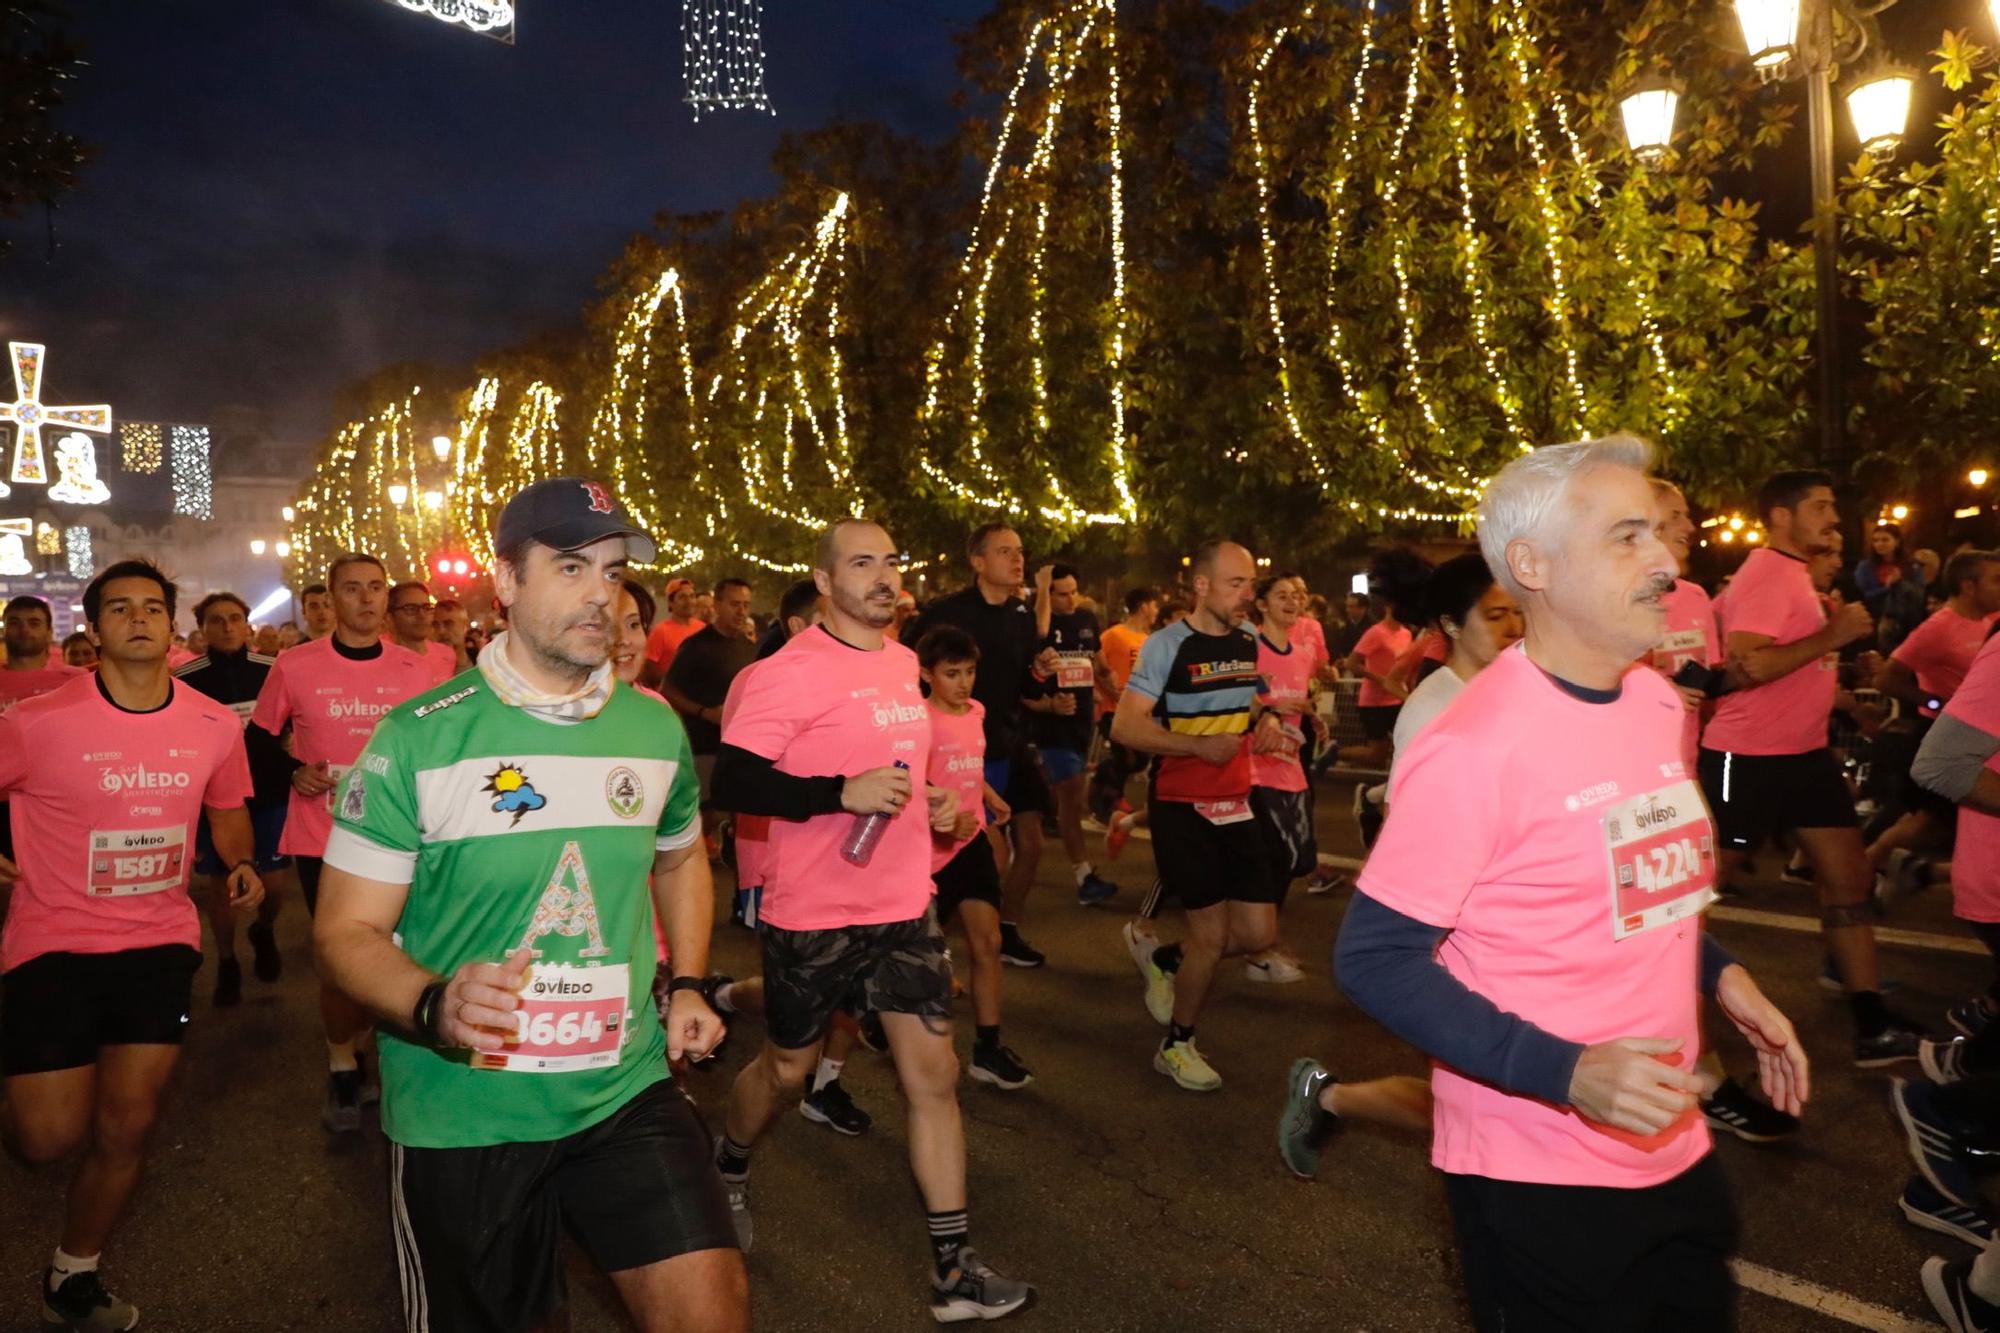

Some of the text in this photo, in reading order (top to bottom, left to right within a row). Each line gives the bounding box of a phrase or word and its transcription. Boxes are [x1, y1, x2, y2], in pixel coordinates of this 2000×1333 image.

[414, 686, 479, 718] Kappa
[101, 763, 189, 790] OVIEDO
[1636, 806, 1677, 828] OVIEDO
[124, 835, 165, 847] OVIEDO
[113, 853, 168, 879] 1587
[1635, 838, 1700, 893] 4224
[505, 840, 611, 957] A
[533, 977, 593, 995] OVIEDO
